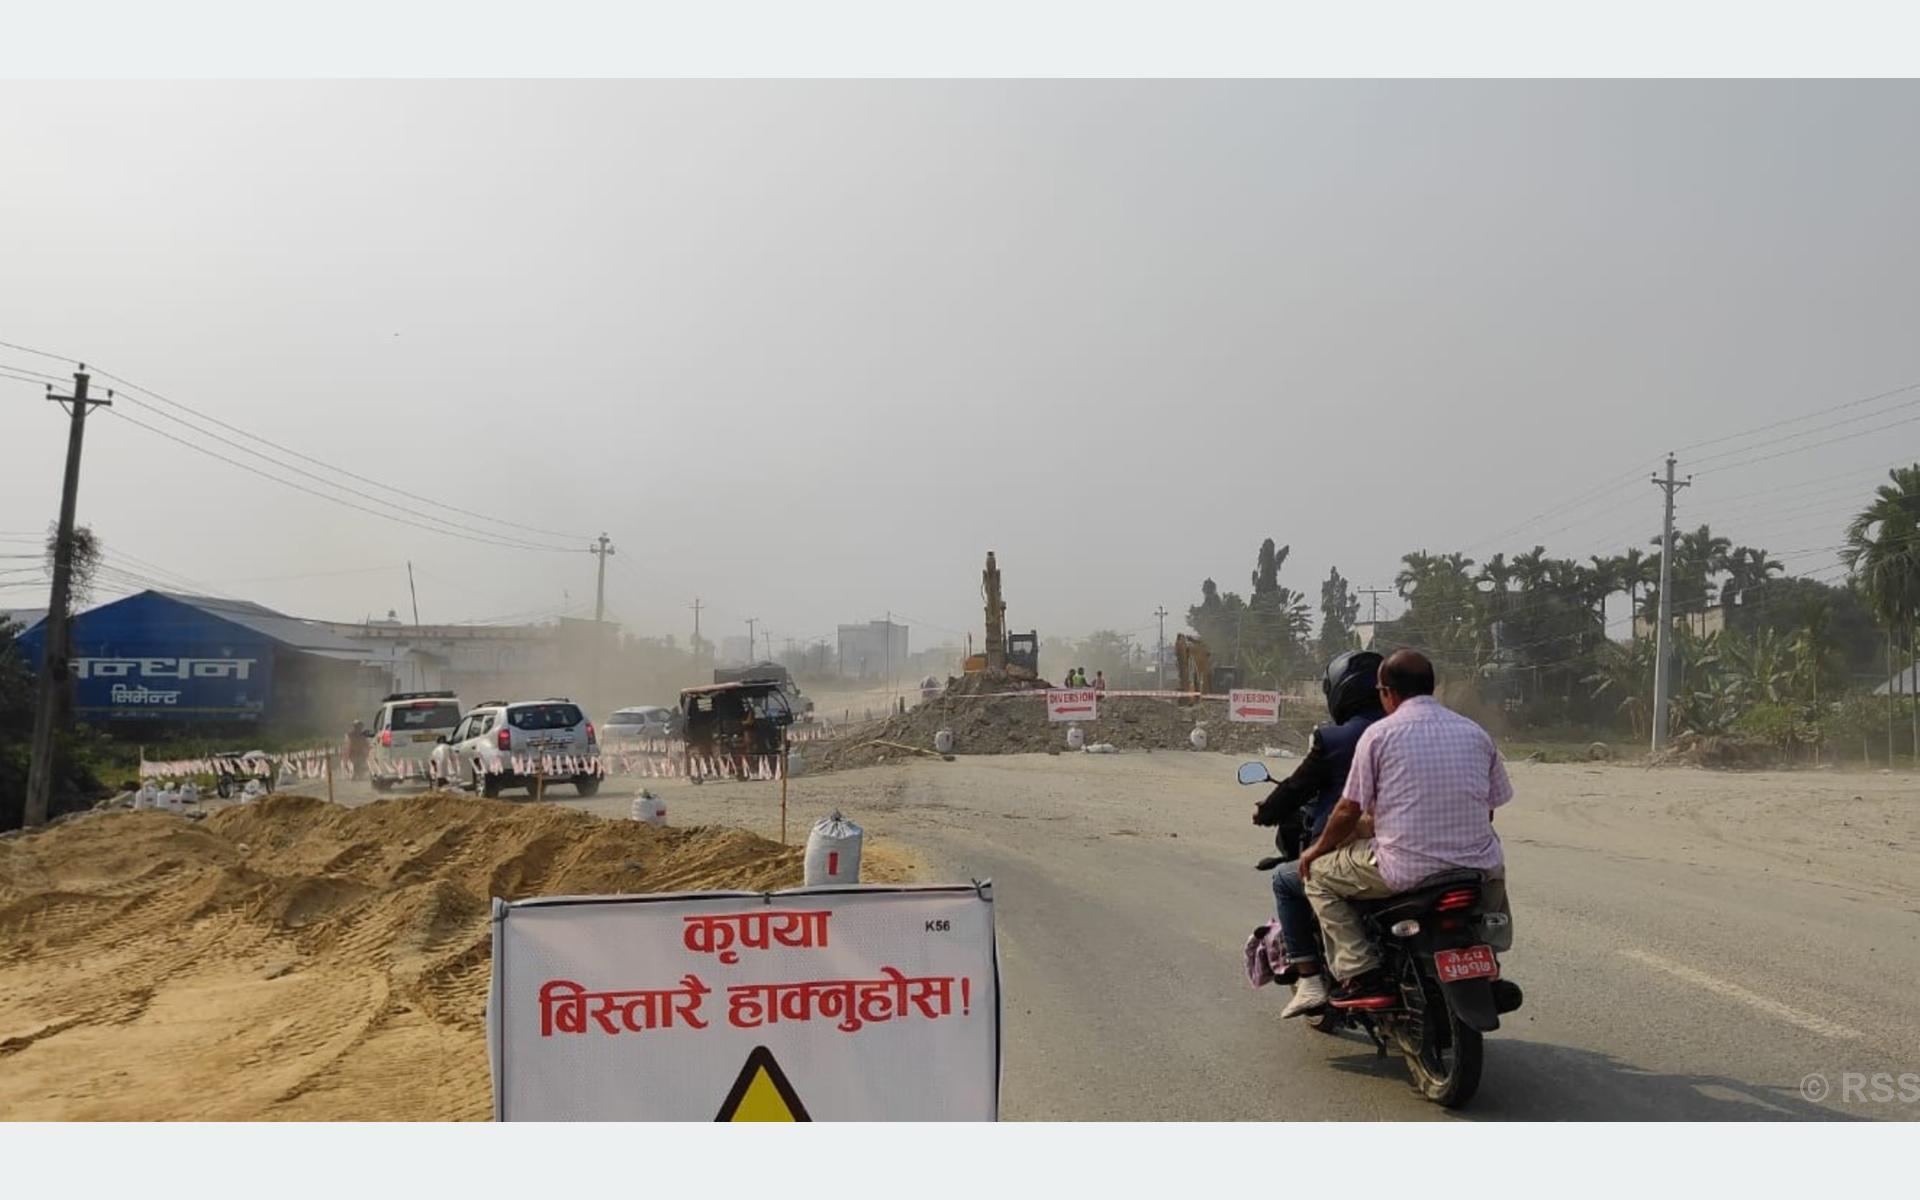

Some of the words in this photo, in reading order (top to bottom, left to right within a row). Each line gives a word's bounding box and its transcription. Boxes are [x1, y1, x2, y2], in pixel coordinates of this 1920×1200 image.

[1050, 691, 1094, 704] DIVERSION
[1232, 693, 1277, 704] DIVERSION
[925, 919, 951, 932] K56
[683, 909, 832, 964] कृपया
[539, 974, 711, 1037] बिस्तारै
